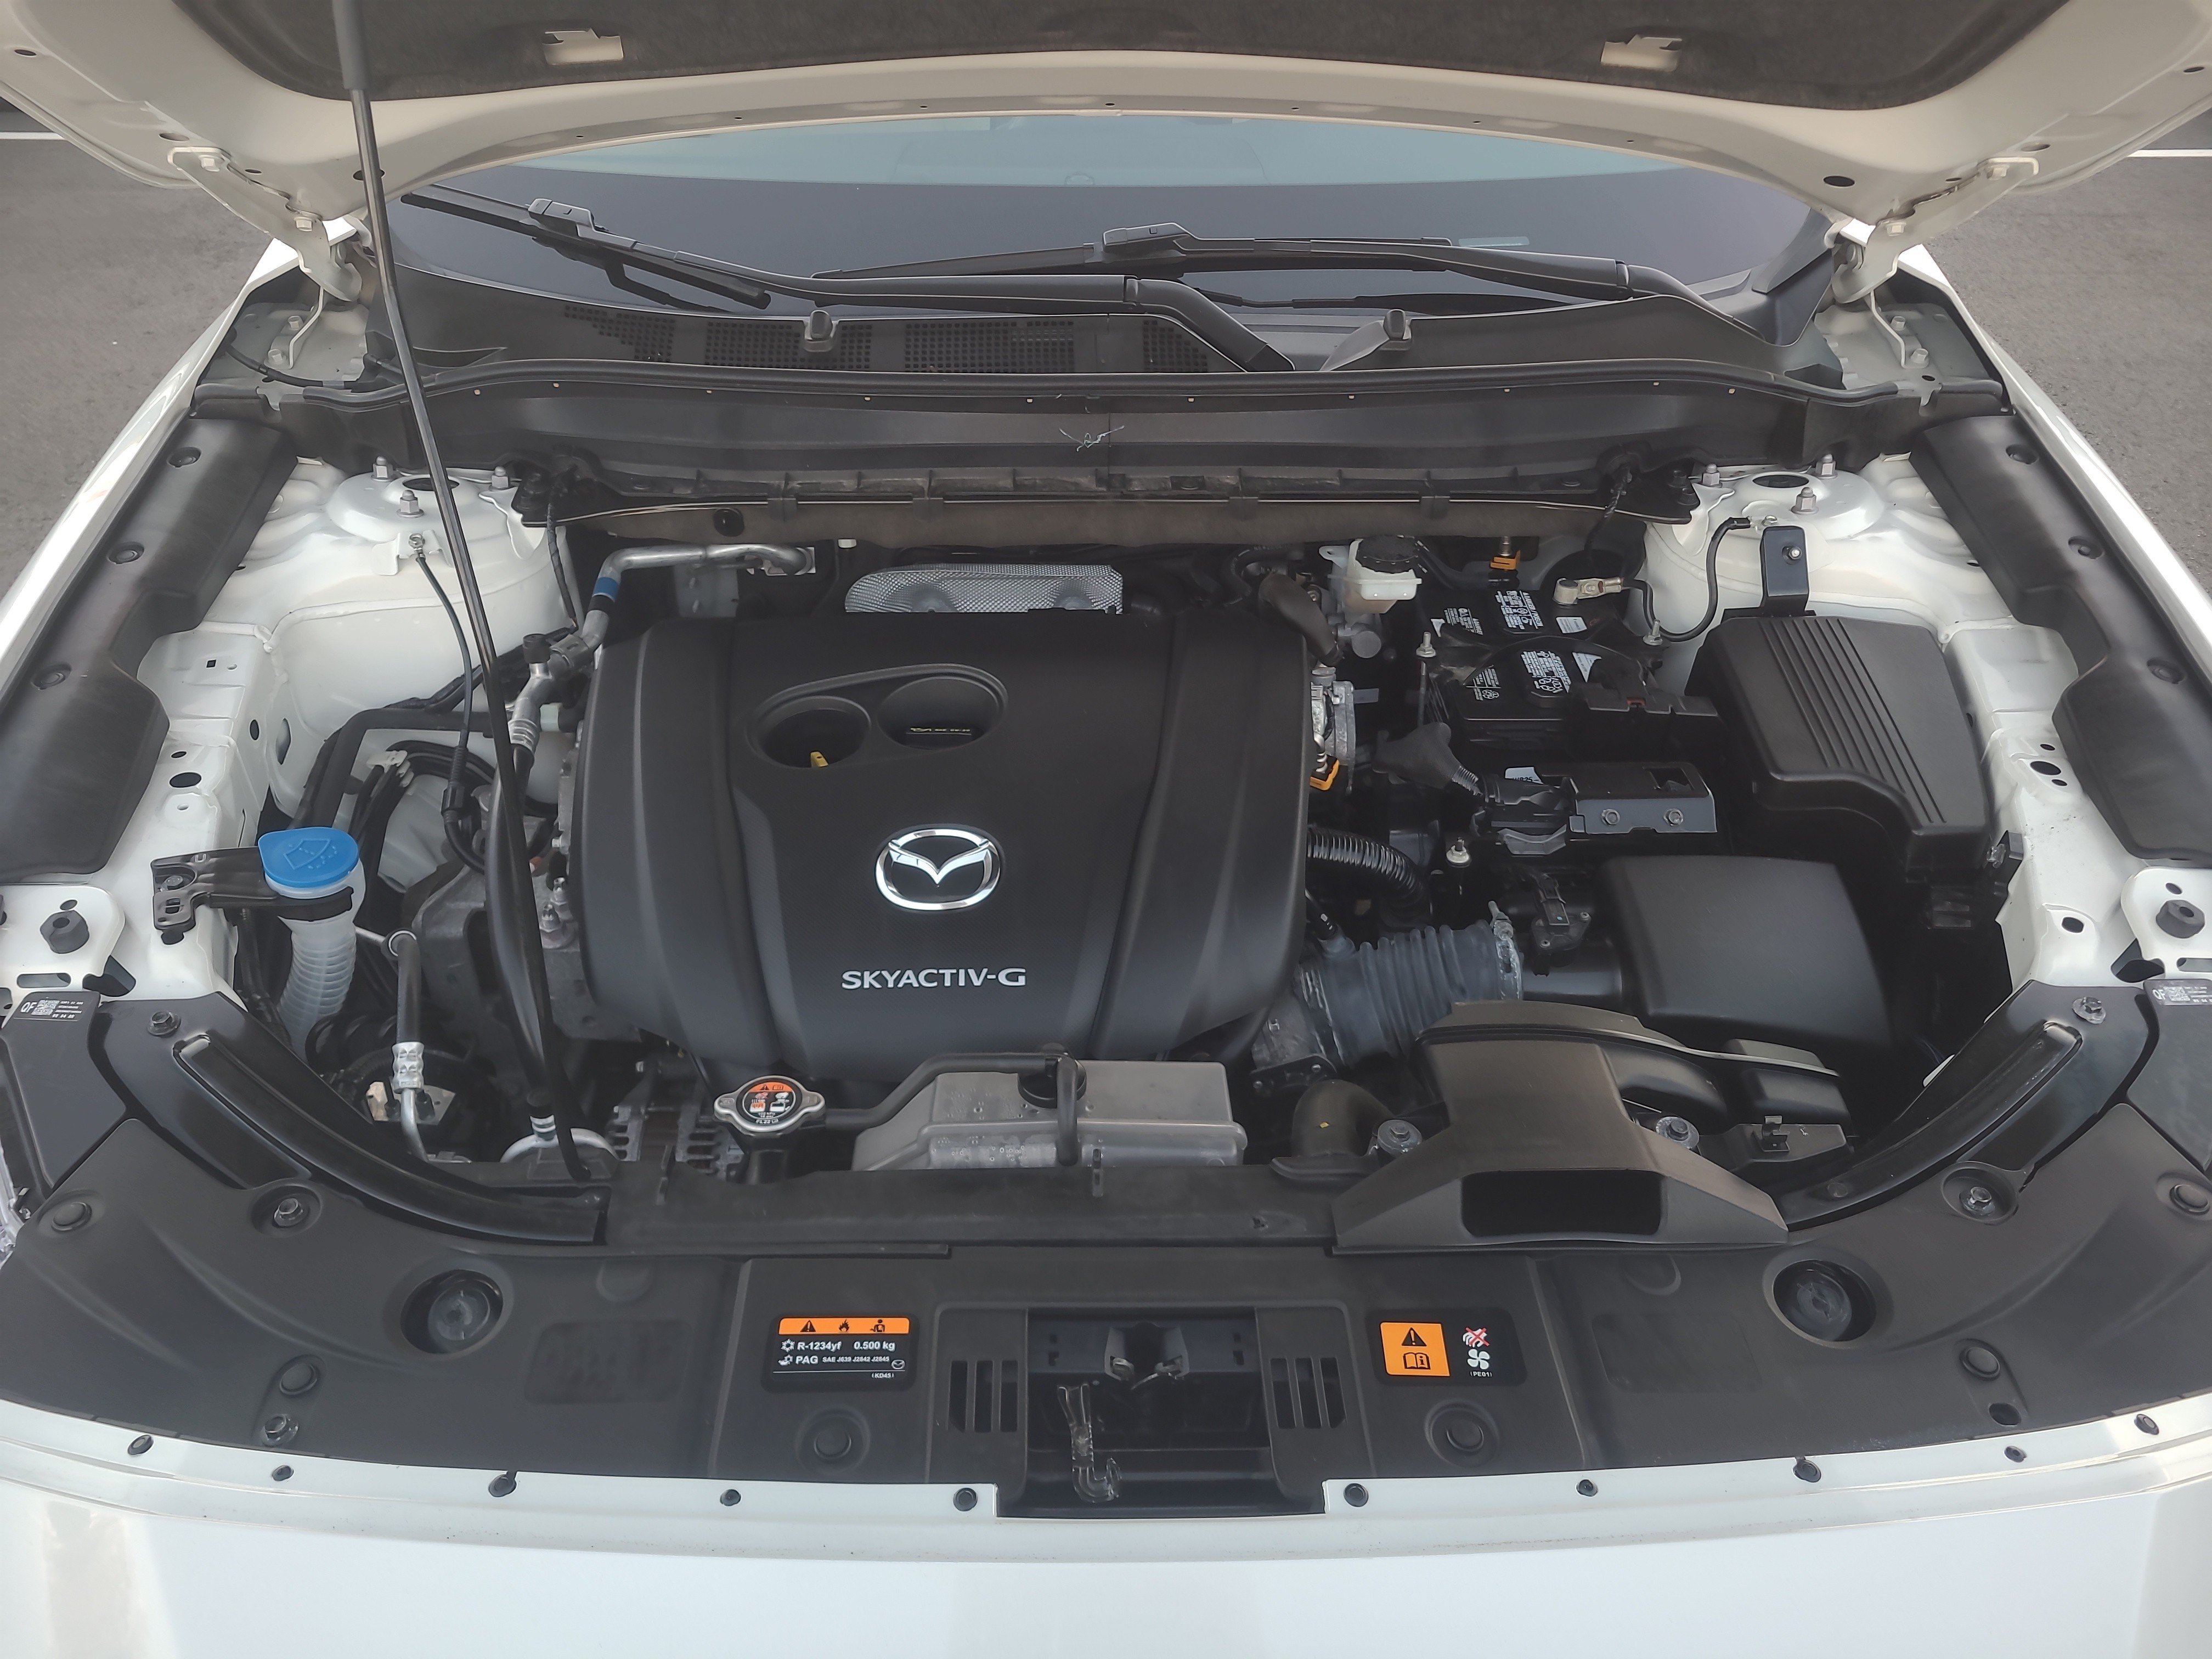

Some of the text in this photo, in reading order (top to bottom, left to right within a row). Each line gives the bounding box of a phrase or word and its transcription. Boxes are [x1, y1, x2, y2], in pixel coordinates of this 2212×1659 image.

[841, 967, 1026, 990] SKYACTIV-G
[797, 1341, 896, 1352] R-1234yf 0.500 kg
[795, 1355, 819, 1365] PAG
